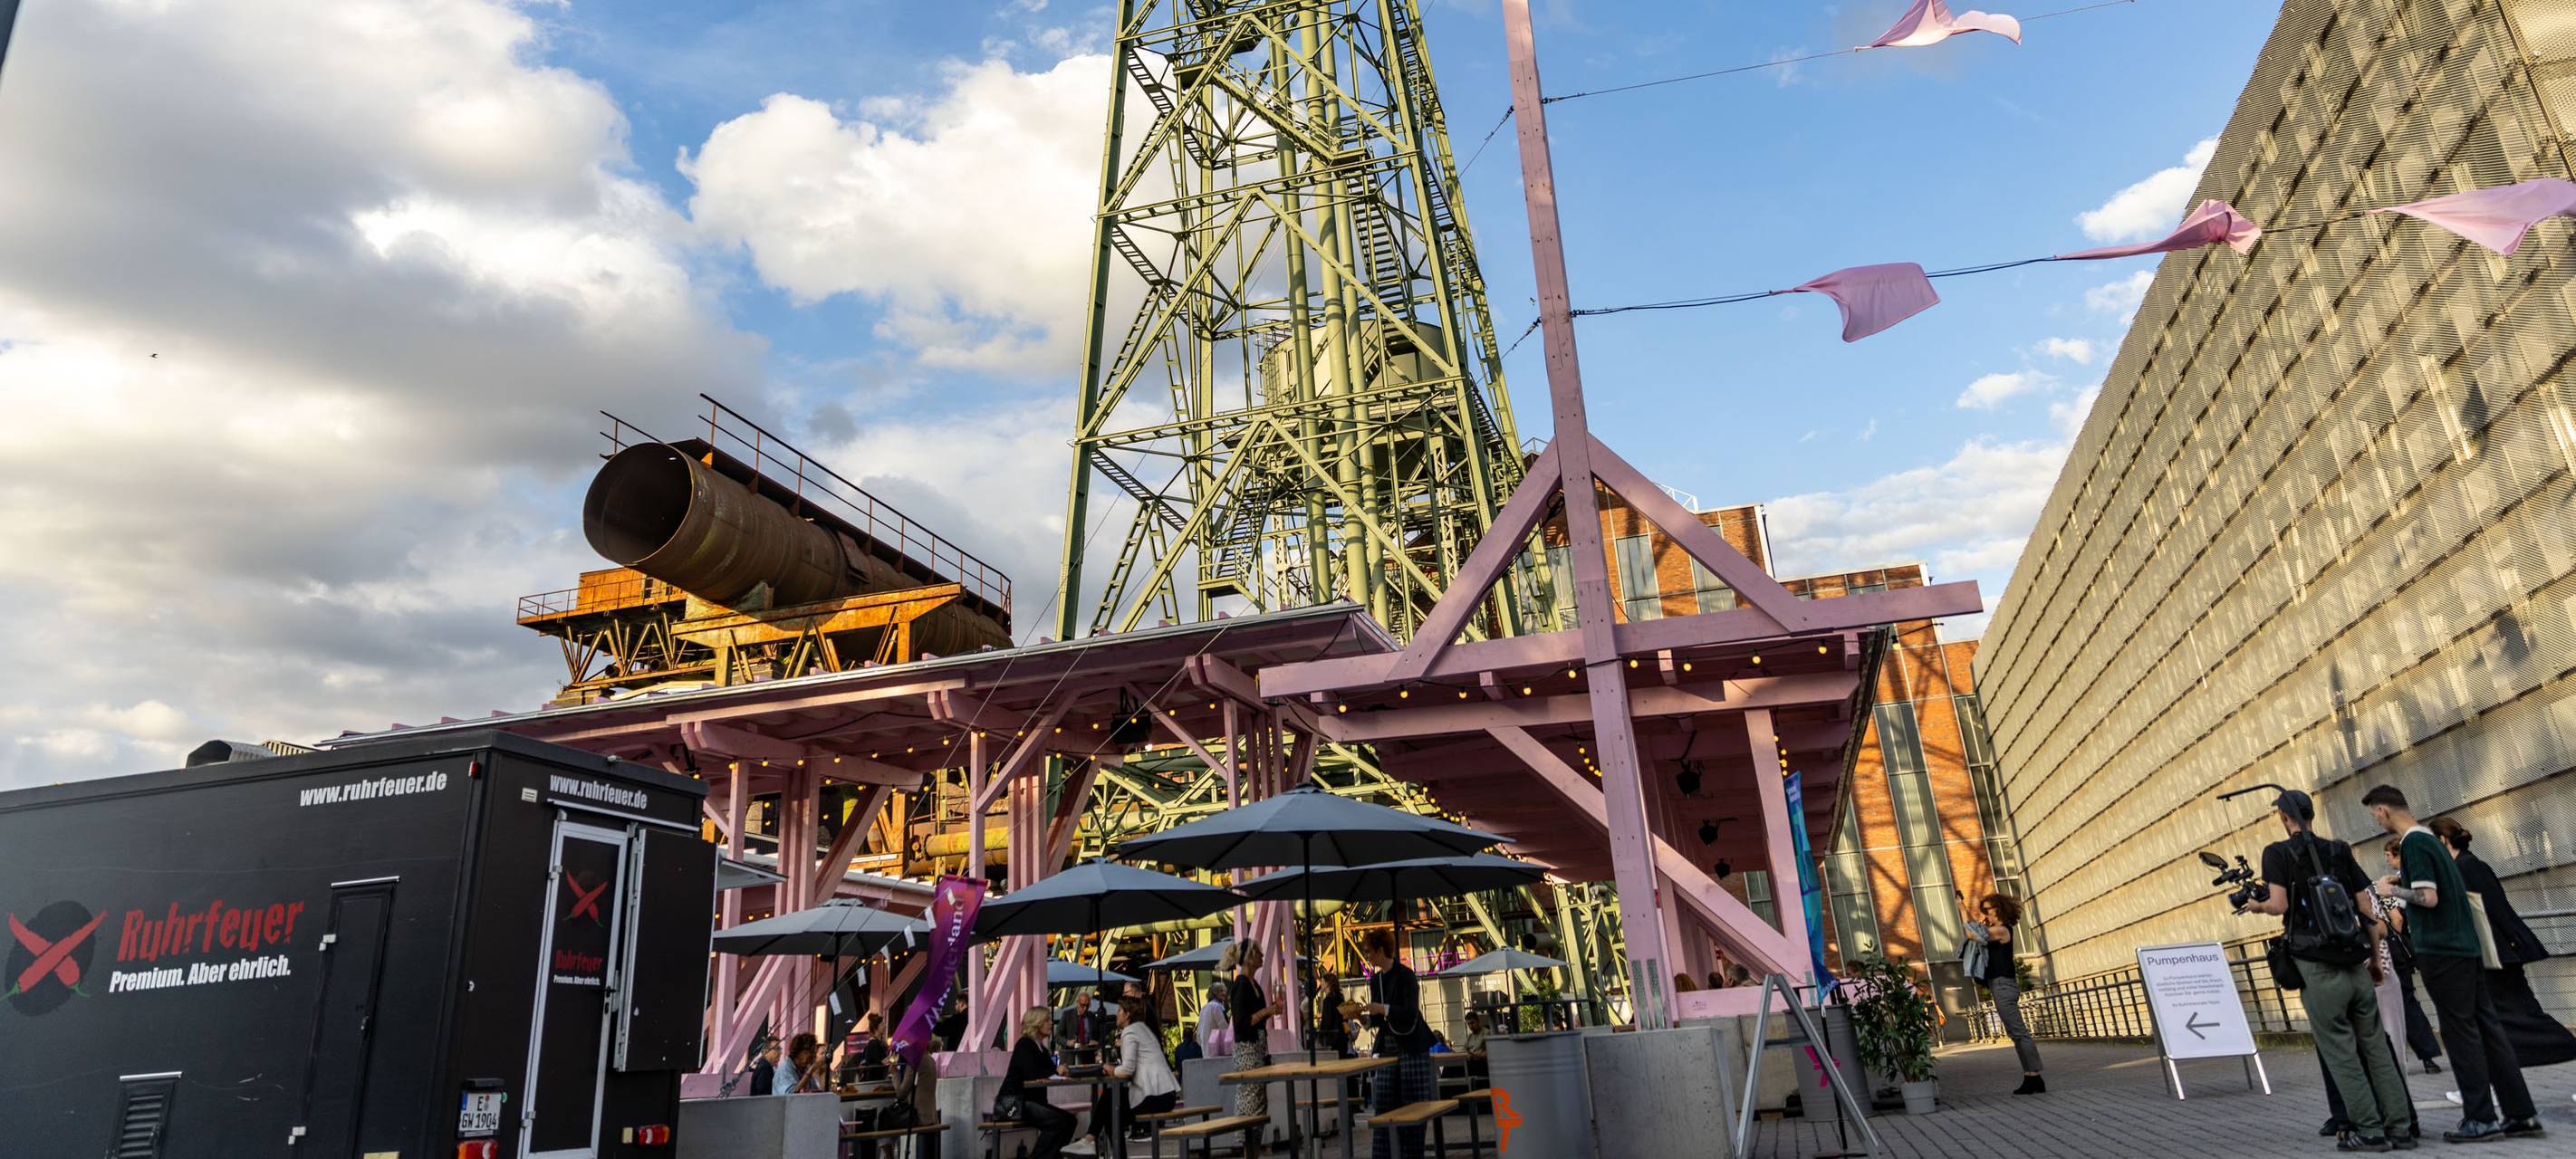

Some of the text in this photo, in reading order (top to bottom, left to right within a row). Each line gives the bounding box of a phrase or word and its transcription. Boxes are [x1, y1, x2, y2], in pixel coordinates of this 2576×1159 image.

[300, 771, 447, 807] www.ruhrfeuer.de
[550, 774, 648, 809] www.ruhrfeuer.de
[116, 899, 305, 963] Ruhrfeuer
[109, 954, 291, 993] Premium. Aber ehrlich.
[2147, 953, 2219, 966] Pumpenhaus
[462, 1113, 497, 1128] GW 1904
[476, 1096, 484, 1112] E
